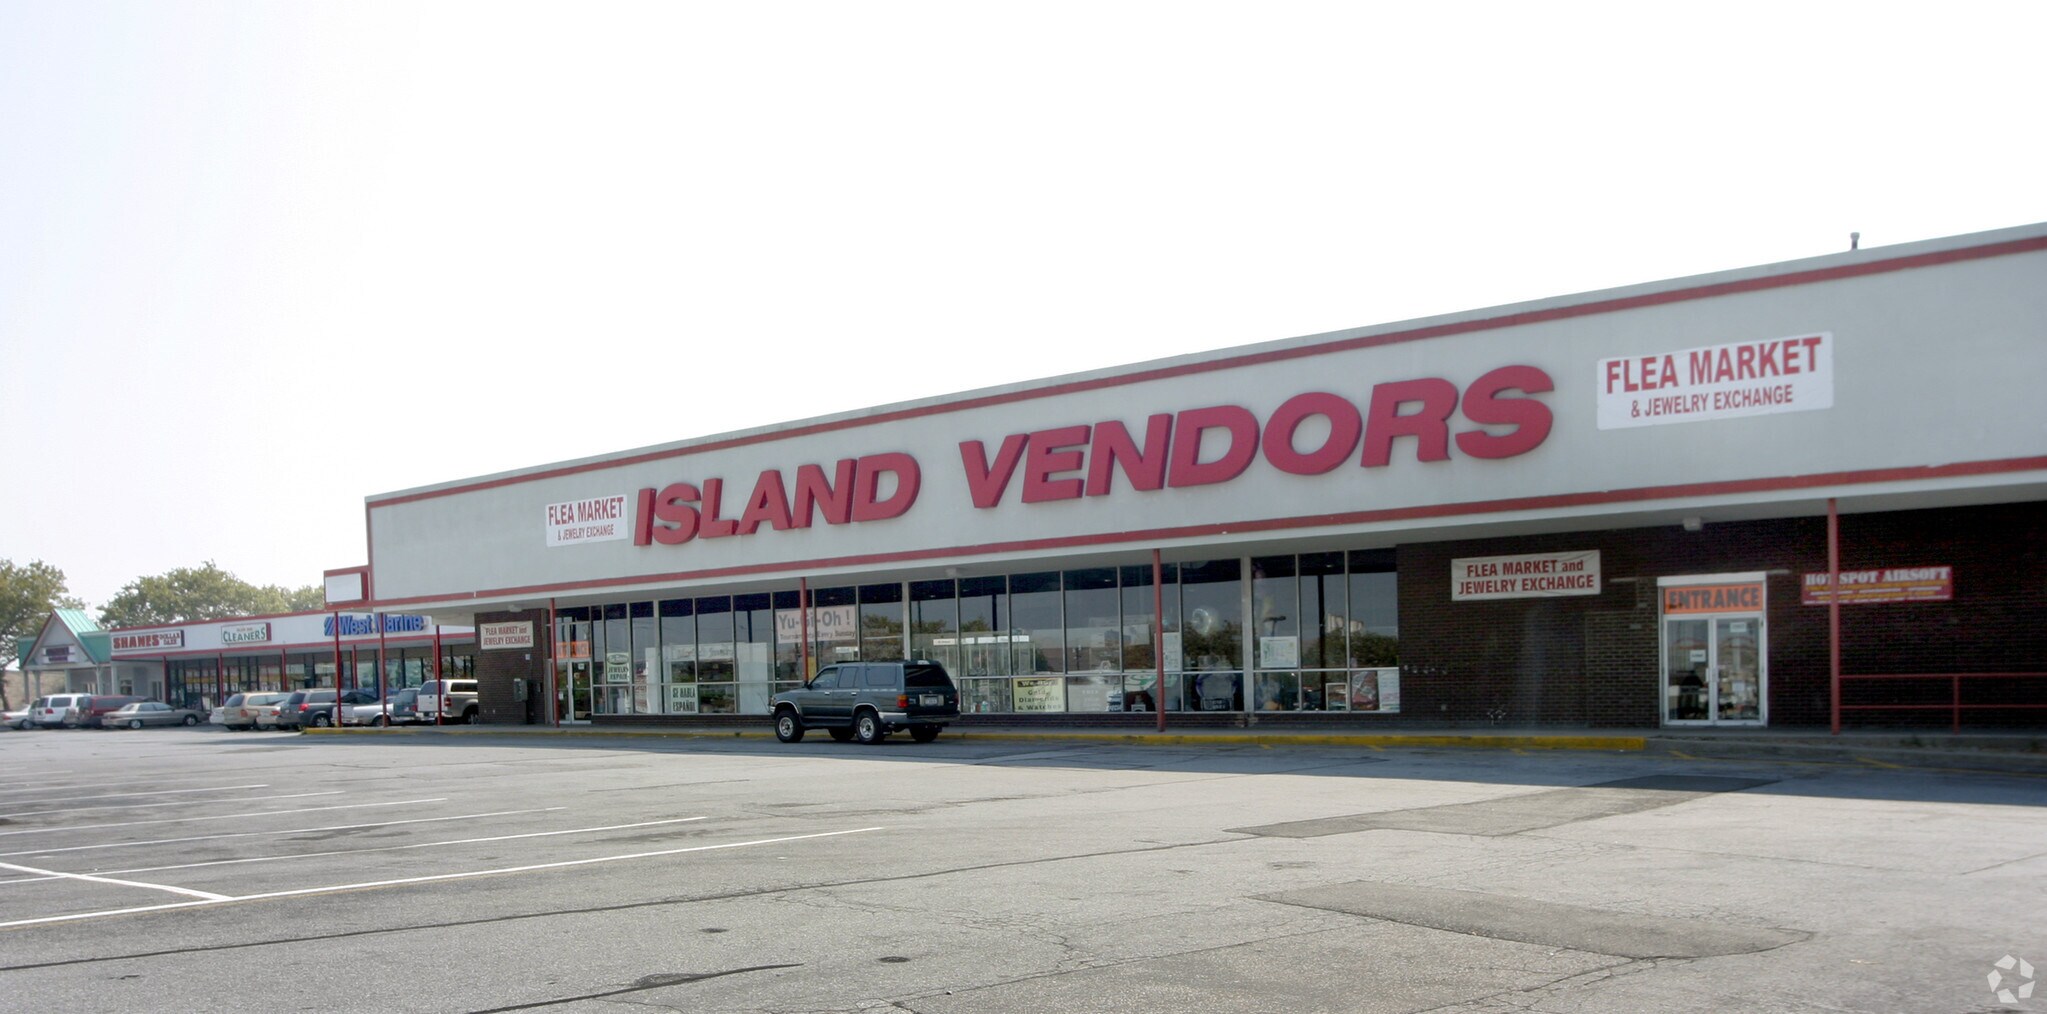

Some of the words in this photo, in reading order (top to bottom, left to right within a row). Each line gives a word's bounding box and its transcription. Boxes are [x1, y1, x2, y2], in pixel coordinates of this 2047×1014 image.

[1606, 354, 1679, 394] FLEA
[1690, 336, 1822, 385] MARKET
[1631, 400, 1640, 418] &
[1644, 392, 1709, 417] JEWELRY
[1714, 384, 1793, 410] EXCHANGE
[634, 452, 921, 546] ISLAND
[956, 364, 1556, 509] VENDORS
[548, 503, 575, 526] FLEA
[578, 497, 624, 522] MARKET
[557, 530, 562, 541] &
[563, 527, 586, 540] JEWELRY
[586, 524, 614, 538] EXCHANGE
[1467, 563, 1498, 577] FLEA
[1503, 560, 1558, 576] MARKET
[1562, 560, 1584, 572] and
[1839, 571, 1878, 584] SPOT
[1882, 567, 1950, 582] AIRSOFT
[1458, 579, 1517, 595] JEWELRY
[1521, 574, 1595, 591] EXCHANGE
[1669, 587, 1760, 609] ENTRANCE
[338, 614, 373, 636] West
[486, 627, 497, 635] FLEA
[498, 626, 518, 635] MARKET
[113, 634, 160, 649] SHANES
[223, 627, 266, 642] CLEANERS
[483, 637, 504, 646] JEWELRY
[505, 635, 531, 645] EXCHANGE
[680, 687, 696, 698] HABLA
